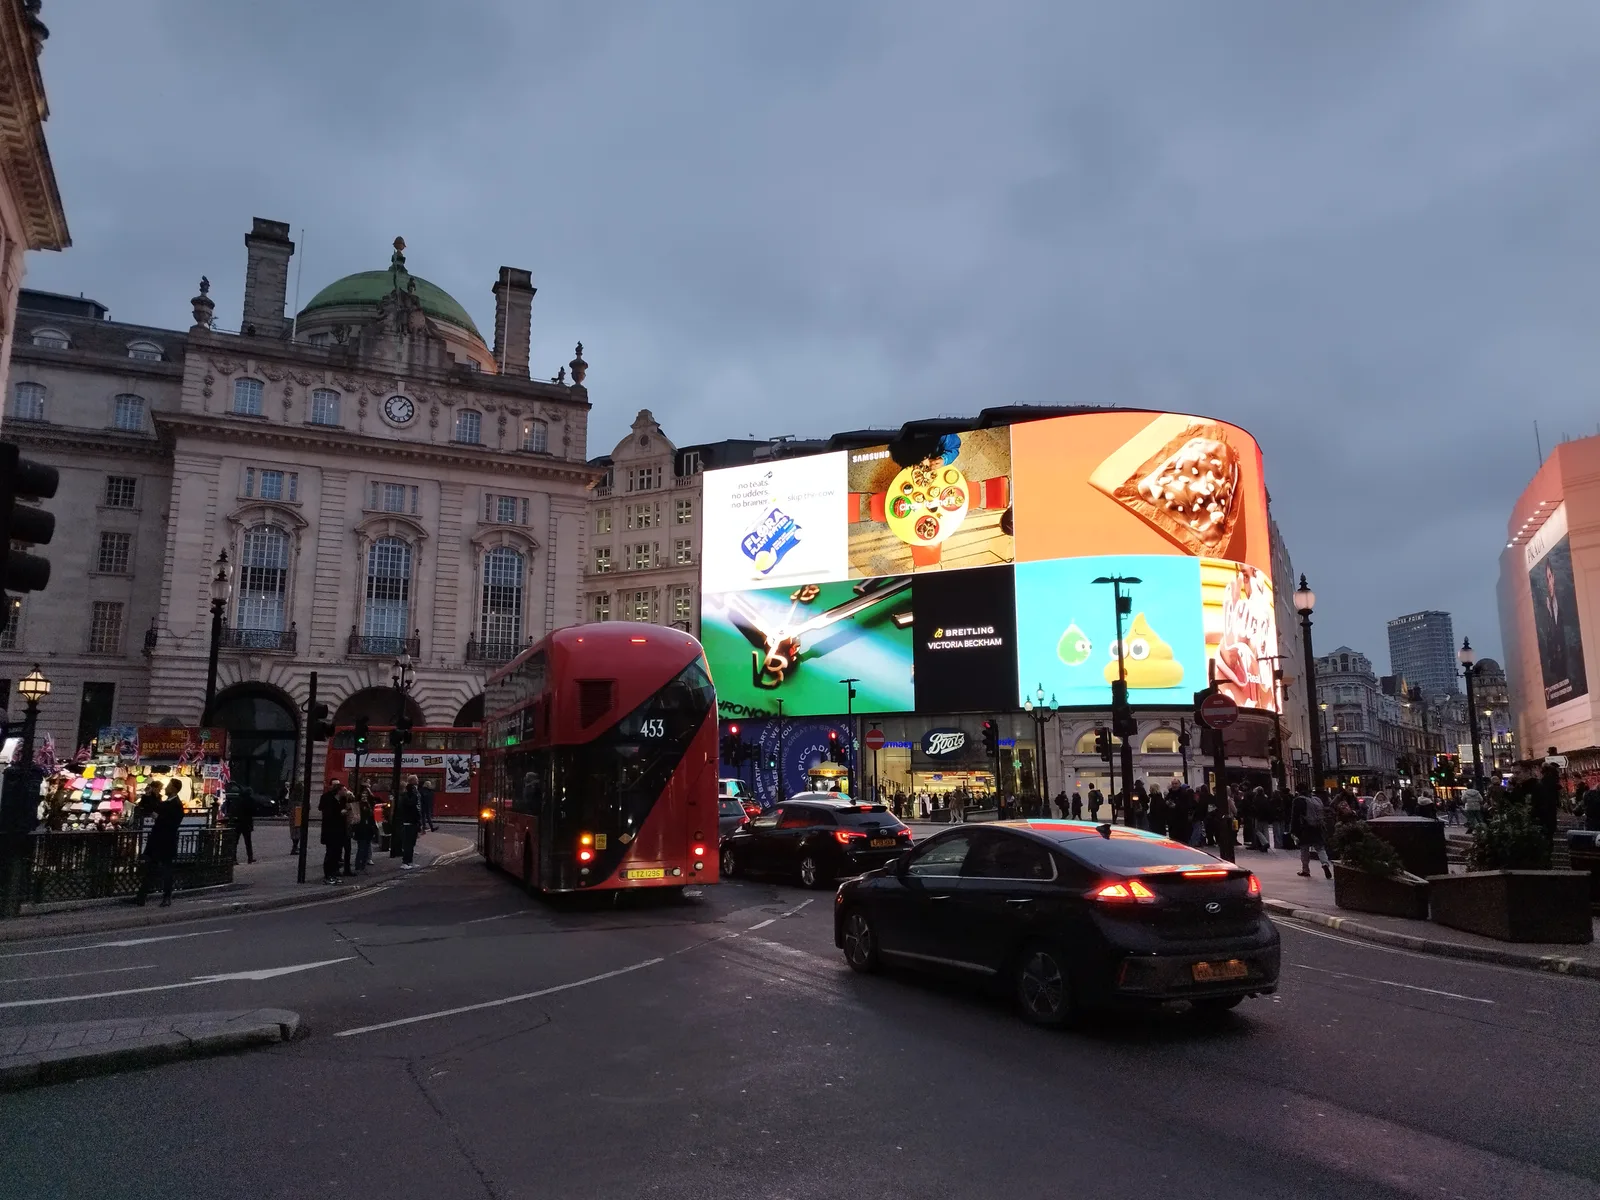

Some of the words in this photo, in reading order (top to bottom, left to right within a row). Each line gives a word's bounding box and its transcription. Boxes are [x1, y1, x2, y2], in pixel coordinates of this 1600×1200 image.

[852, 450, 890, 463] SAMSUNG
[743, 510, 785, 551] FLORA
[945, 627, 994, 637] BREITLING
[927, 641, 963, 649] VICTORIA
[964, 638, 1002, 648] BECKHAM
[640, 719, 664, 738] 453
[926, 733, 965, 755] Boots
